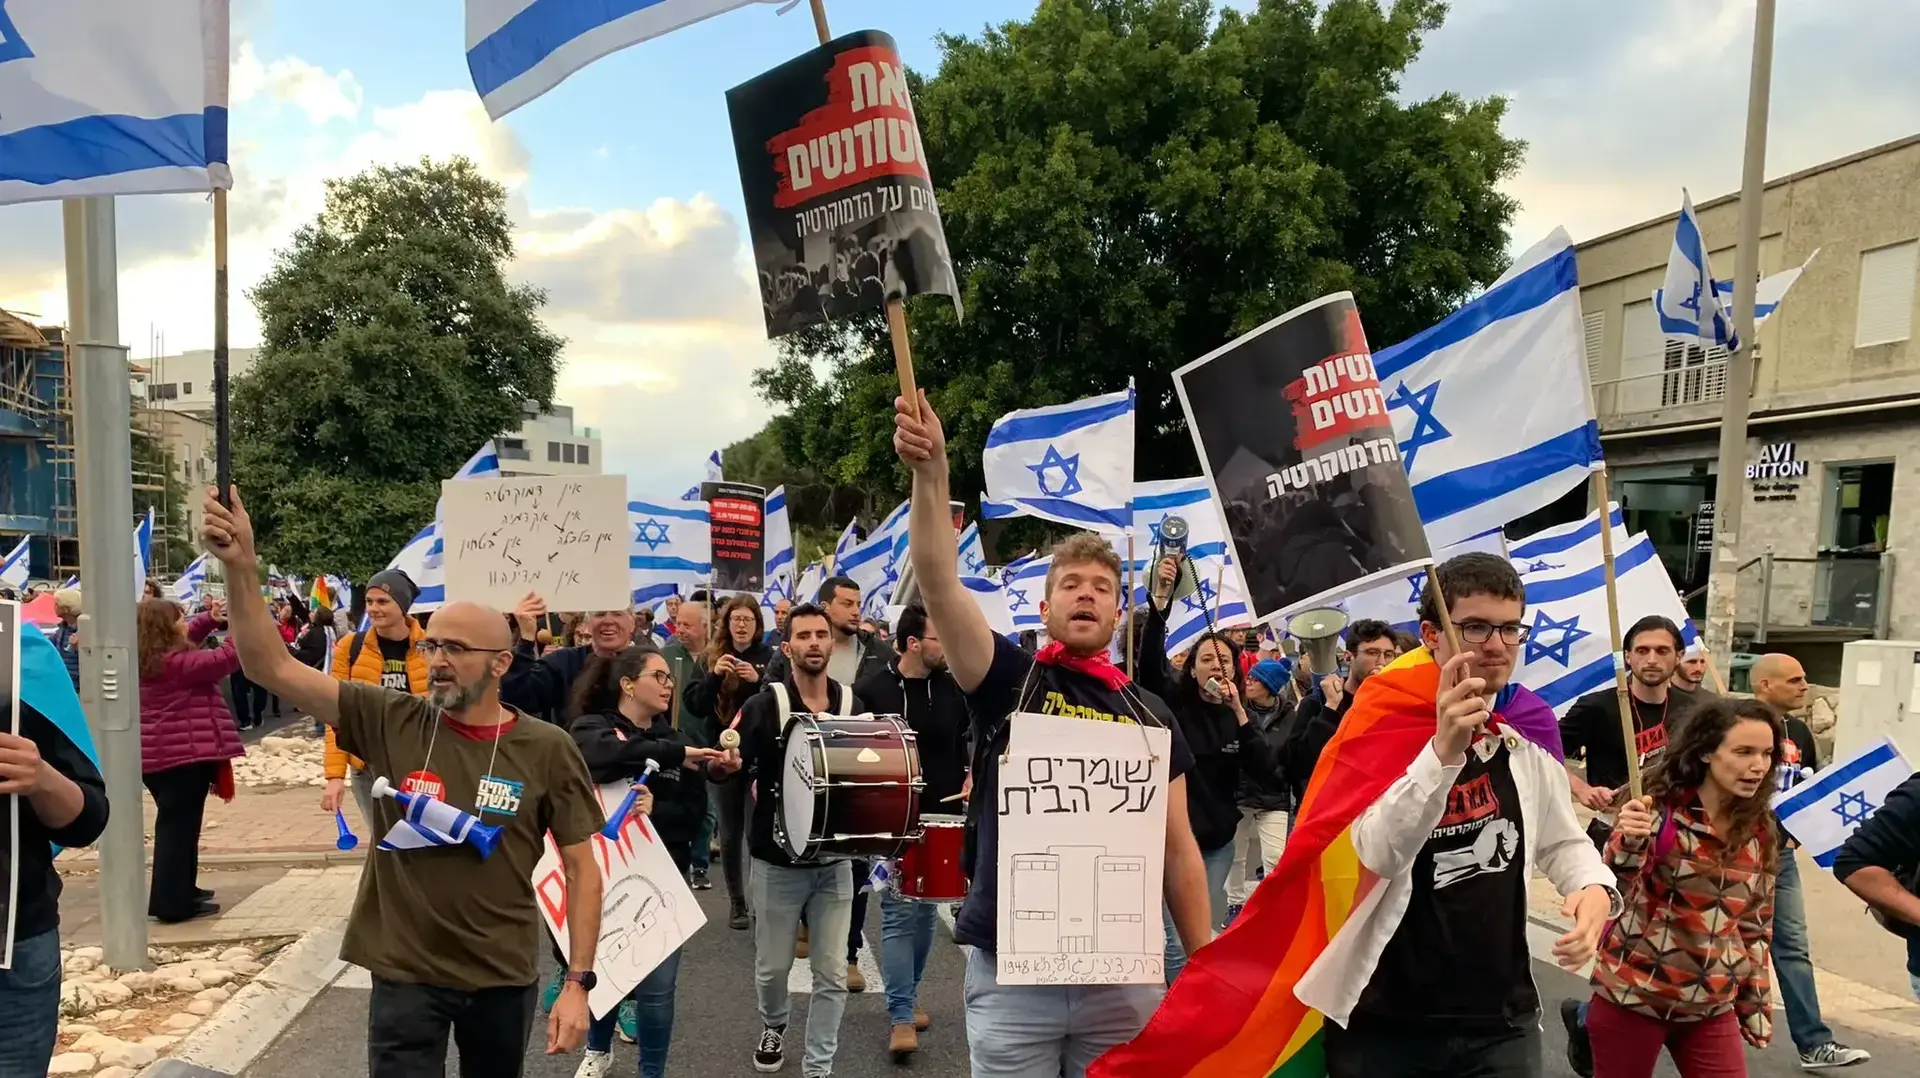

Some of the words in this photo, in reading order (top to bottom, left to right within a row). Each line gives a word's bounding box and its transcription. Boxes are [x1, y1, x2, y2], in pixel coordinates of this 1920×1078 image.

[847, 60, 911, 113] את
[877, 184, 903, 213] על
[909, 185, 938, 216] מים
[795, 191, 874, 238] הדמוקרטיה
[1302, 353, 1377, 397] נטיות
[1758, 442, 1793, 463] AVI
[1266, 438, 1398, 500] הדמוקרטיה
[1744, 460, 1807, 479] BITTON
[484, 484, 544, 506] דמוקרטיה
[557, 483, 582, 508] אין
[501, 512, 549, 531] אקדמיה
[562, 510, 581, 529] אין
[459, 532, 496, 560] בטחון
[502, 536, 522, 559] אין
[557, 529, 592, 546] כלכלה
[594, 532, 613, 554] אין
[555, 570, 580, 596] אין
[1028, 757, 1153, 785] שומרים
[406, 778, 441, 795] שומרי
[479, 778, 512, 797] אחים
[1109, 779, 1156, 813] על
[475, 792, 520, 812] לנשק
[998, 783, 1090, 816] הבית
[1003, 959, 1030, 975] 1948
[1127, 956, 1162, 976] בית
